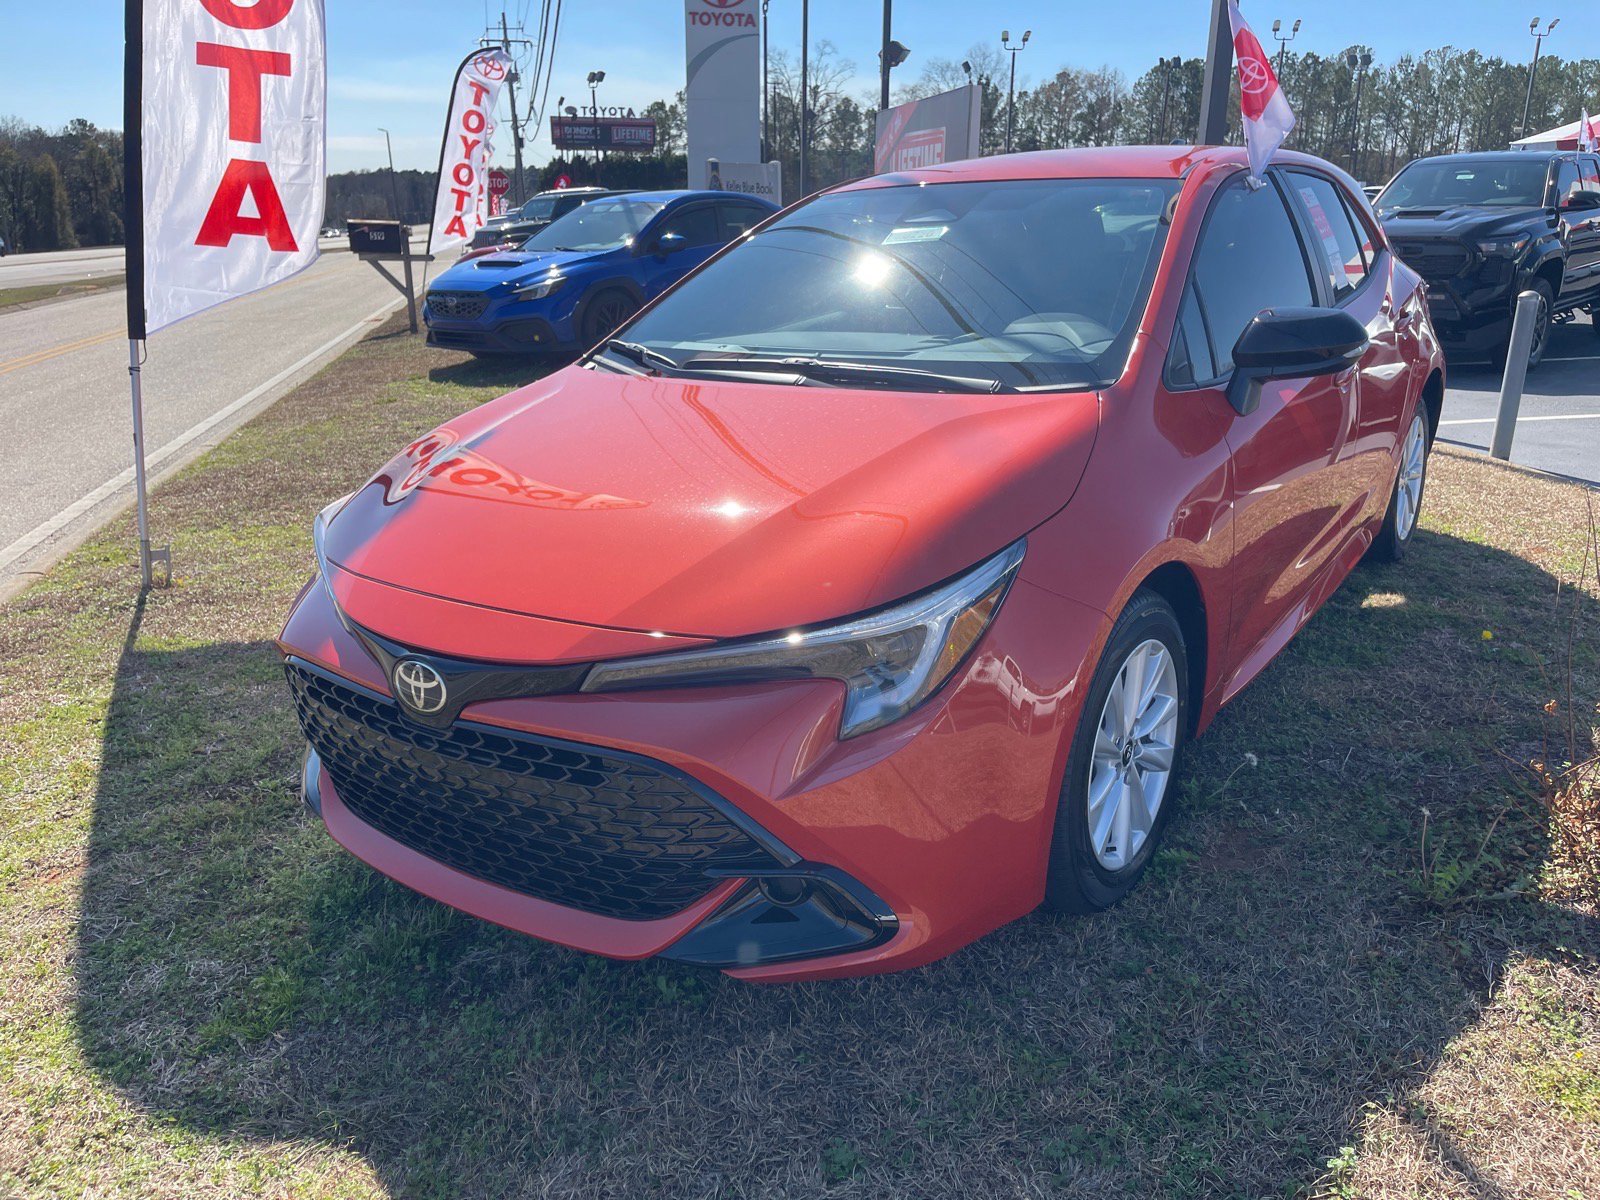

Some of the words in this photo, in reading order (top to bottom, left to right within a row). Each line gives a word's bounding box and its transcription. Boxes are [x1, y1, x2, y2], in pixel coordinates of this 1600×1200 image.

[688, 12, 756, 27] TOYOTA
[581, 106, 635, 117] TOYOTA
[613, 127, 652, 140] LIFETIME
[444, 81, 490, 238] TOYOTA
[488, 178, 507, 188] STOP
[743, 182, 755, 193] Blue
[756, 182, 773, 194] Book
